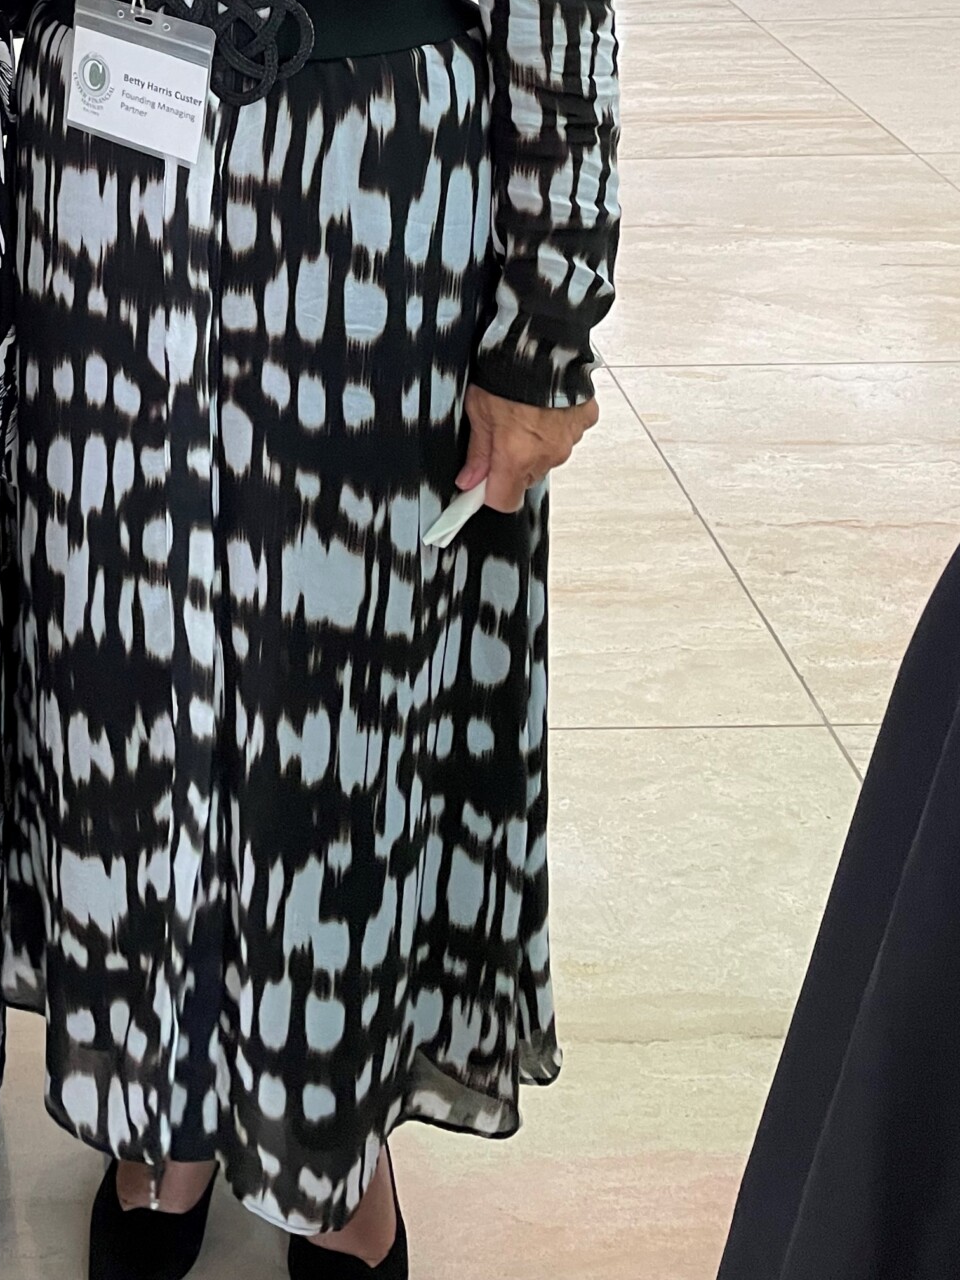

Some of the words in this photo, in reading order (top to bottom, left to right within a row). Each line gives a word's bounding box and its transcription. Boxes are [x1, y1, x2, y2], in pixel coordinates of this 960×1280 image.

[121, 90, 156, 109] Founding
[157, 102, 196, 123] Managing
[123, 73, 146, 89] Betty
[147, 81, 173, 97] Harris
[174, 91, 202, 107] Custer
[120, 101, 148, 117] Partner
